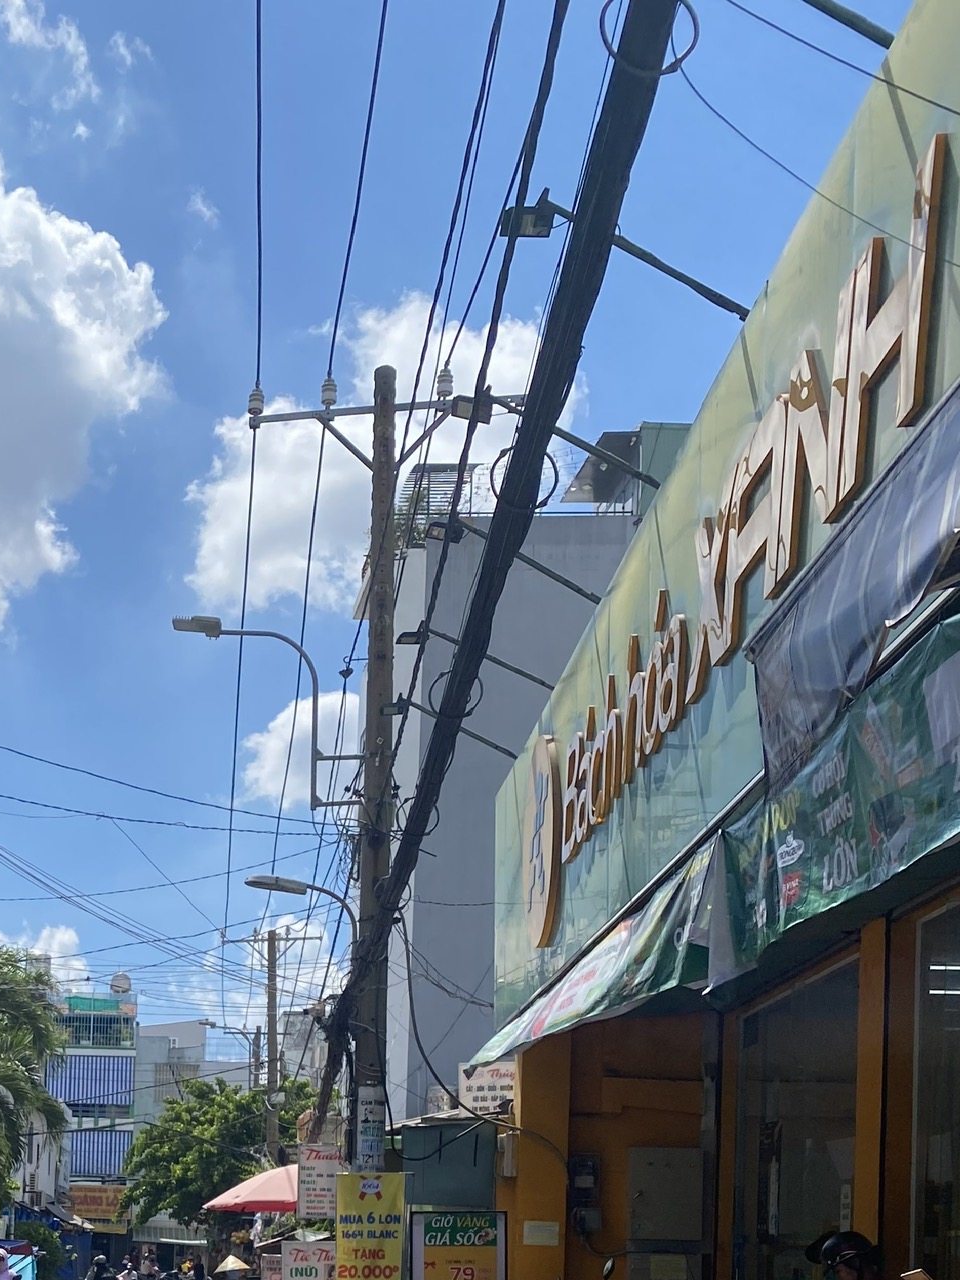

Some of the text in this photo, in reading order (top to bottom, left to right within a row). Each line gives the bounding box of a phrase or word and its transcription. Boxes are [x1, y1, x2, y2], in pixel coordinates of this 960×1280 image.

[560, 672, 622, 866] Bách
[684, 132, 948, 705] XANH
[340, 1211, 402, 1225] MUA 6 LON
[431, 1214, 490, 1228] GIỜ VÀNG
[341, 1229, 399, 1239] 1664 BLANC
[425, 1227, 486, 1246] GIÁ SỐC
[289, 1264, 318, 1279] (NỮ)
